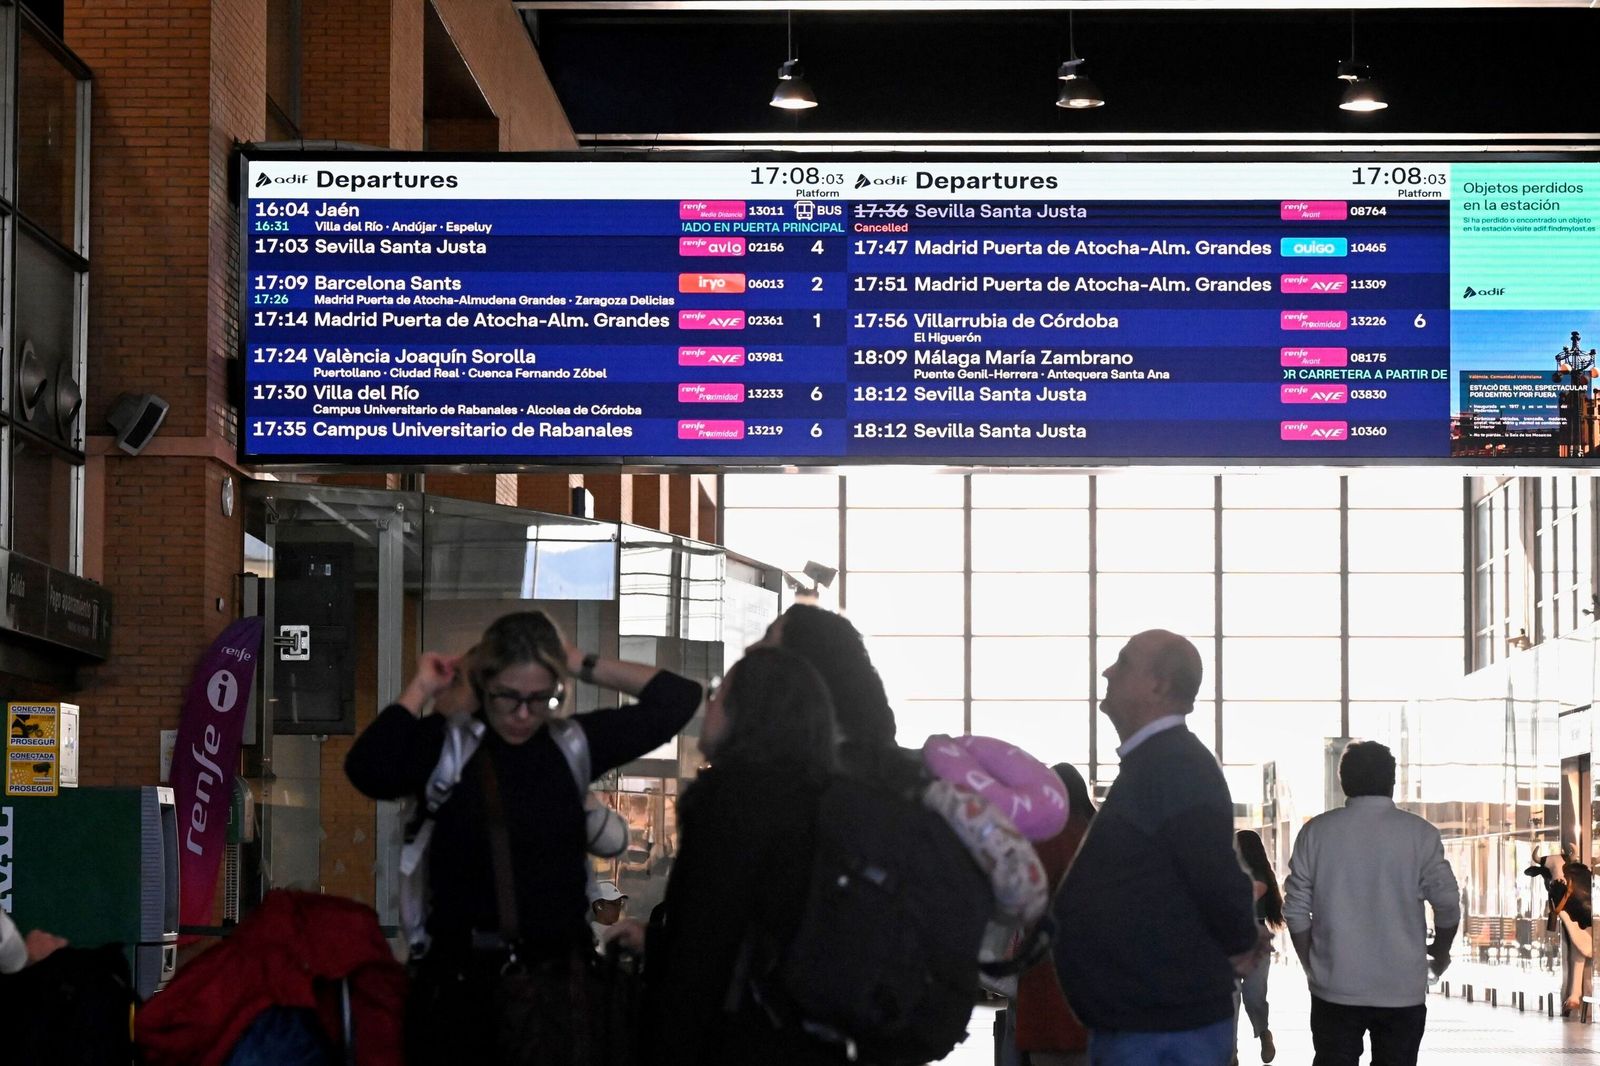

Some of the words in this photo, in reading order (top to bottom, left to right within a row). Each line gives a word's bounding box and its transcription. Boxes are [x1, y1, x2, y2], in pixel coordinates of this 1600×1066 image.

[274, 174, 309, 184] adif
[317, 170, 458, 193] Departures
[873, 175, 909, 185] adif
[916, 171, 1058, 194] Departures
[796, 189, 840, 198] Platform
[1398, 189, 1442, 198] Platform
[1463, 182, 1518, 197] Objetos
[1522, 182, 1584, 196] perdidos
[255, 202, 310, 217] 16:04
[315, 202, 360, 217] Jaén
[749, 206, 785, 216] 13011
[817, 205, 842, 215] BUS
[915, 203, 975, 218] Sevilla
[980, 203, 1032, 218] Santa
[1036, 204, 1087, 218] Justa
[1350, 206, 1387, 216] 08764
[1463, 202, 1480, 211] en
[1484, 199, 1497, 211] la
[1500, 199, 1560, 211] estación
[255, 220, 289, 231] 16:31
[315, 221, 341, 232] Villa
[343, 221, 362, 232] del
[364, 221, 384, 232] Río
[391, 221, 438, 234] Andújar
[446, 221, 493, 235] Espeluy
[714, 222, 730, 232] EN
[733, 222, 780, 232] PUERTA
[783, 222, 845, 233] PRINCIPAL
[854, 223, 908, 232] Cancelled
[255, 238, 309, 253] 17:03
[315, 238, 375, 254] Sevilla
[380, 239, 432, 254] Santa
[436, 239, 487, 254] Justa
[748, 242, 784, 252] 02156
[811, 240, 824, 255] 4
[854, 240, 908, 255] 17:47
[915, 239, 978, 255] Madrid
[983, 240, 1043, 255] Puerta
[1047, 240, 1070, 255] de
[1074, 240, 1191, 255] Atocha-Alm.
[1195, 240, 1272, 255] Grandes
[1351, 243, 1387, 253] 10465
[255, 275, 308, 290] 17:09
[315, 275, 406, 290] Barcelona
[410, 275, 462, 291] Sants
[748, 279, 784, 289] 06013
[811, 276, 823, 291] 2
[1478, 287, 1506, 296] adif
[254, 293, 289, 305] 17:26
[314, 294, 354, 305] Madrid
[356, 294, 394, 305] Puerta
[396, 294, 411, 305] de
[413, 294, 517, 305] Atocha-Almudena
[518, 295, 567, 305] Grandes
[575, 295, 628, 307] Zaragoza
[630, 295, 675, 306] Delicias
[254, 311, 308, 327] 17:14
[314, 311, 377, 327] Madrid
[382, 312, 442, 327] Puerta
[446, 312, 469, 327] de
[473, 312, 589, 328] Atocha-Alm.
[593, 312, 670, 328] Grandes
[748, 316, 784, 326] 02361
[813, 313, 821, 328] 1
[854, 313, 908, 328] 17:56
[913, 313, 1008, 328] Villarrubia
[1012, 313, 1035, 328] de
[1039, 313, 1119, 328] Córdoba
[1351, 316, 1387, 326] 13226
[1414, 313, 1426, 328] 6
[914, 332, 926, 343] El
[928, 331, 982, 345] Higuerón
[254, 348, 308, 363] 17:24
[313, 348, 390, 364] València
[394, 348, 467, 367] Joaquín
[471, 348, 536, 364] Sorolla
[747, 352, 784, 362] 03981
[854, 350, 908, 365] 18:09
[914, 349, 981, 369] Málaga
[985, 349, 1036, 365] María
[1040, 349, 1133, 365] Zambrano
[1350, 353, 1387, 363] 08175
[313, 367, 381, 378] Puertollano
[389, 367, 431, 378] Ciudad
[433, 367, 460, 378] Real
[468, 367, 513, 378] Cuenca
[515, 368, 571, 378] Fernando
[573, 367, 607, 379] Zóbel
[914, 369, 955, 379] Puente
[957, 369, 1039, 379] Genil-Herrera
[1047, 369, 1108, 382] Antequera
[1110, 369, 1145, 379] Santa
[1146, 369, 1170, 379] Ana
[1299, 369, 1372, 379] CARRETERA
[1386, 369, 1428, 379] PARTIR
[1431, 369, 1448, 379] DE
[253, 384, 307, 400] 17:30
[313, 384, 353, 400] Villa
[357, 384, 387, 400] del
[391, 385, 420, 400] Río
[748, 389, 784, 399] 13233
[810, 386, 823, 401] 6
[854, 386, 908, 401] 18:12
[914, 386, 975, 401] Sevilla
[979, 386, 1031, 402] Santa
[1036, 386, 1087, 402] Justa
[1350, 390, 1387, 399] 03830
[313, 404, 361, 417] Campus
[363, 404, 438, 415] Universitario
[440, 404, 456, 415] de
[457, 404, 518, 415] Rabanales
[526, 404, 571, 415] Alcolea
[573, 405, 589, 415] de
[590, 404, 642, 415] Córdoba
[253, 421, 307, 436] 17:35
[313, 421, 388, 440] Campus
[392, 421, 507, 437] Universitario
[511, 422, 535, 437] de
[539, 422, 633, 437] Rabanales
[747, 425, 783, 435] 13219
[810, 423, 823, 438] 6
[221, 646, 251, 662] renfe
[186, 724, 224, 856] renfe
